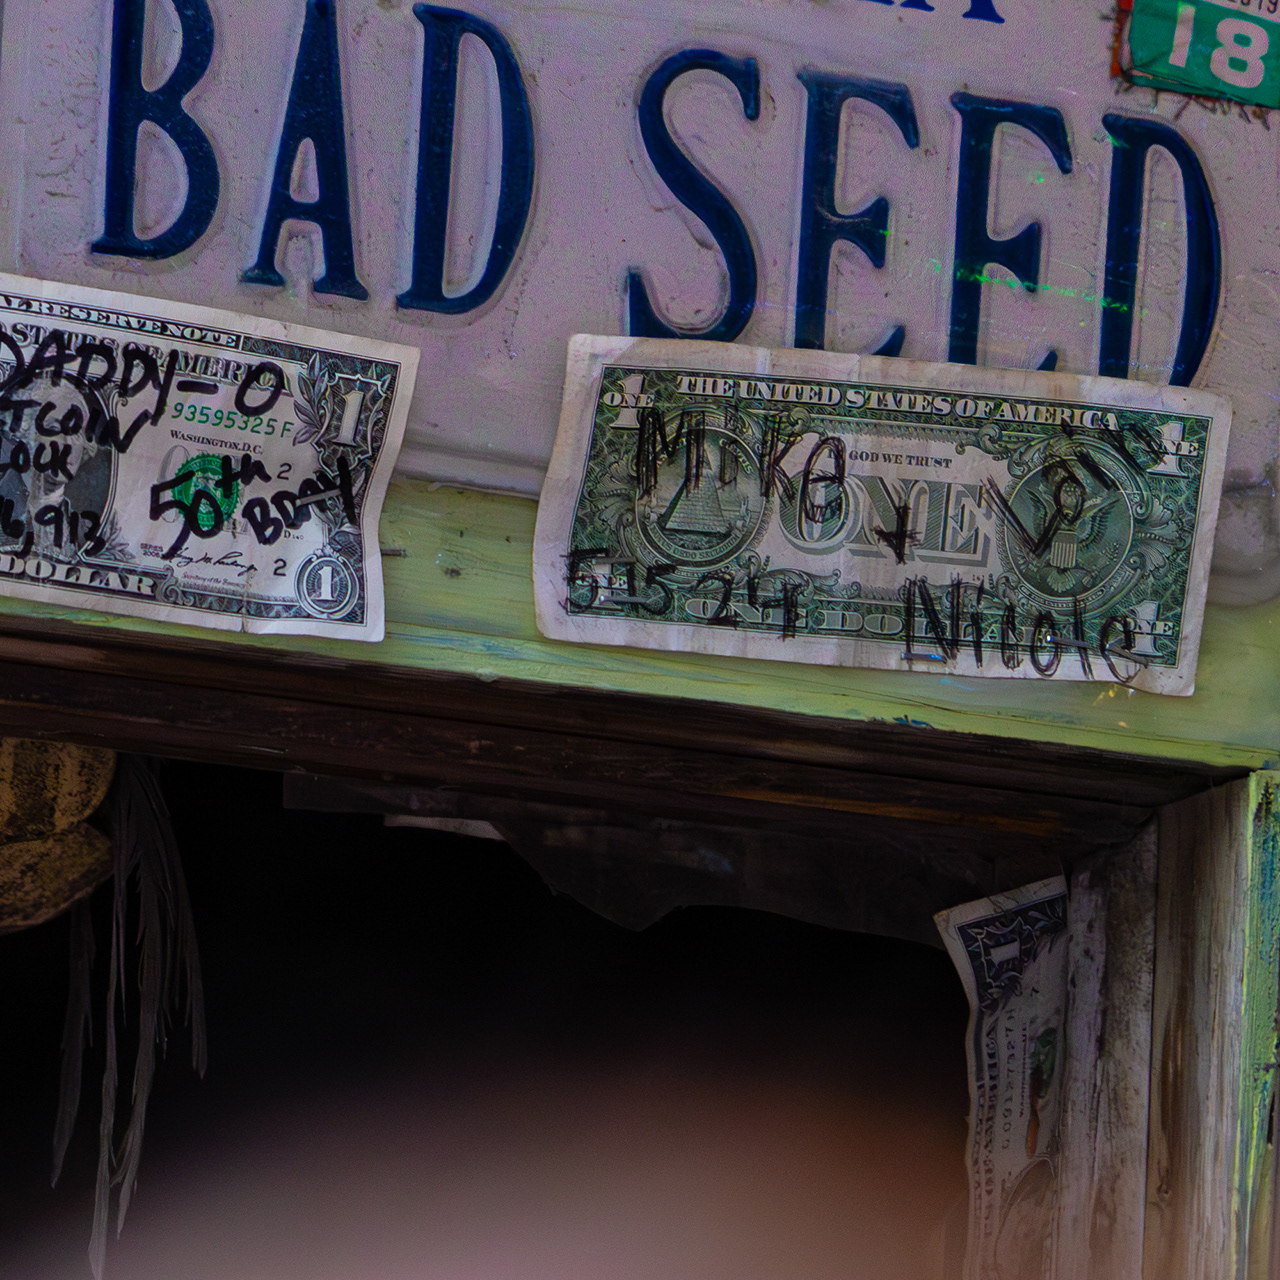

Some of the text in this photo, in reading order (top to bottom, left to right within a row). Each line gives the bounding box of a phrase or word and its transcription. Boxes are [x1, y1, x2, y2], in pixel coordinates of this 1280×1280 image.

[1169, 0, 1270, 88] 18
[627, 48, 1222, 387] SEED
[29, 299, 165, 336] RESERVE
[166, 323, 238, 350] NOTE
[164, 402, 295, 438] 93595325F
[338, 389, 367, 447] 1
[602, 391, 655, 409] ONE
[676, 375, 1120, 431] THE UNITED STATES OF AMERICA
[276, 462, 293, 481] 2
[849, 449, 953, 470] GOD WE TRUST
[778, 472, 992, 569] ONE
[273, 558, 288, 577] 2
[317, 564, 336, 601] 1
